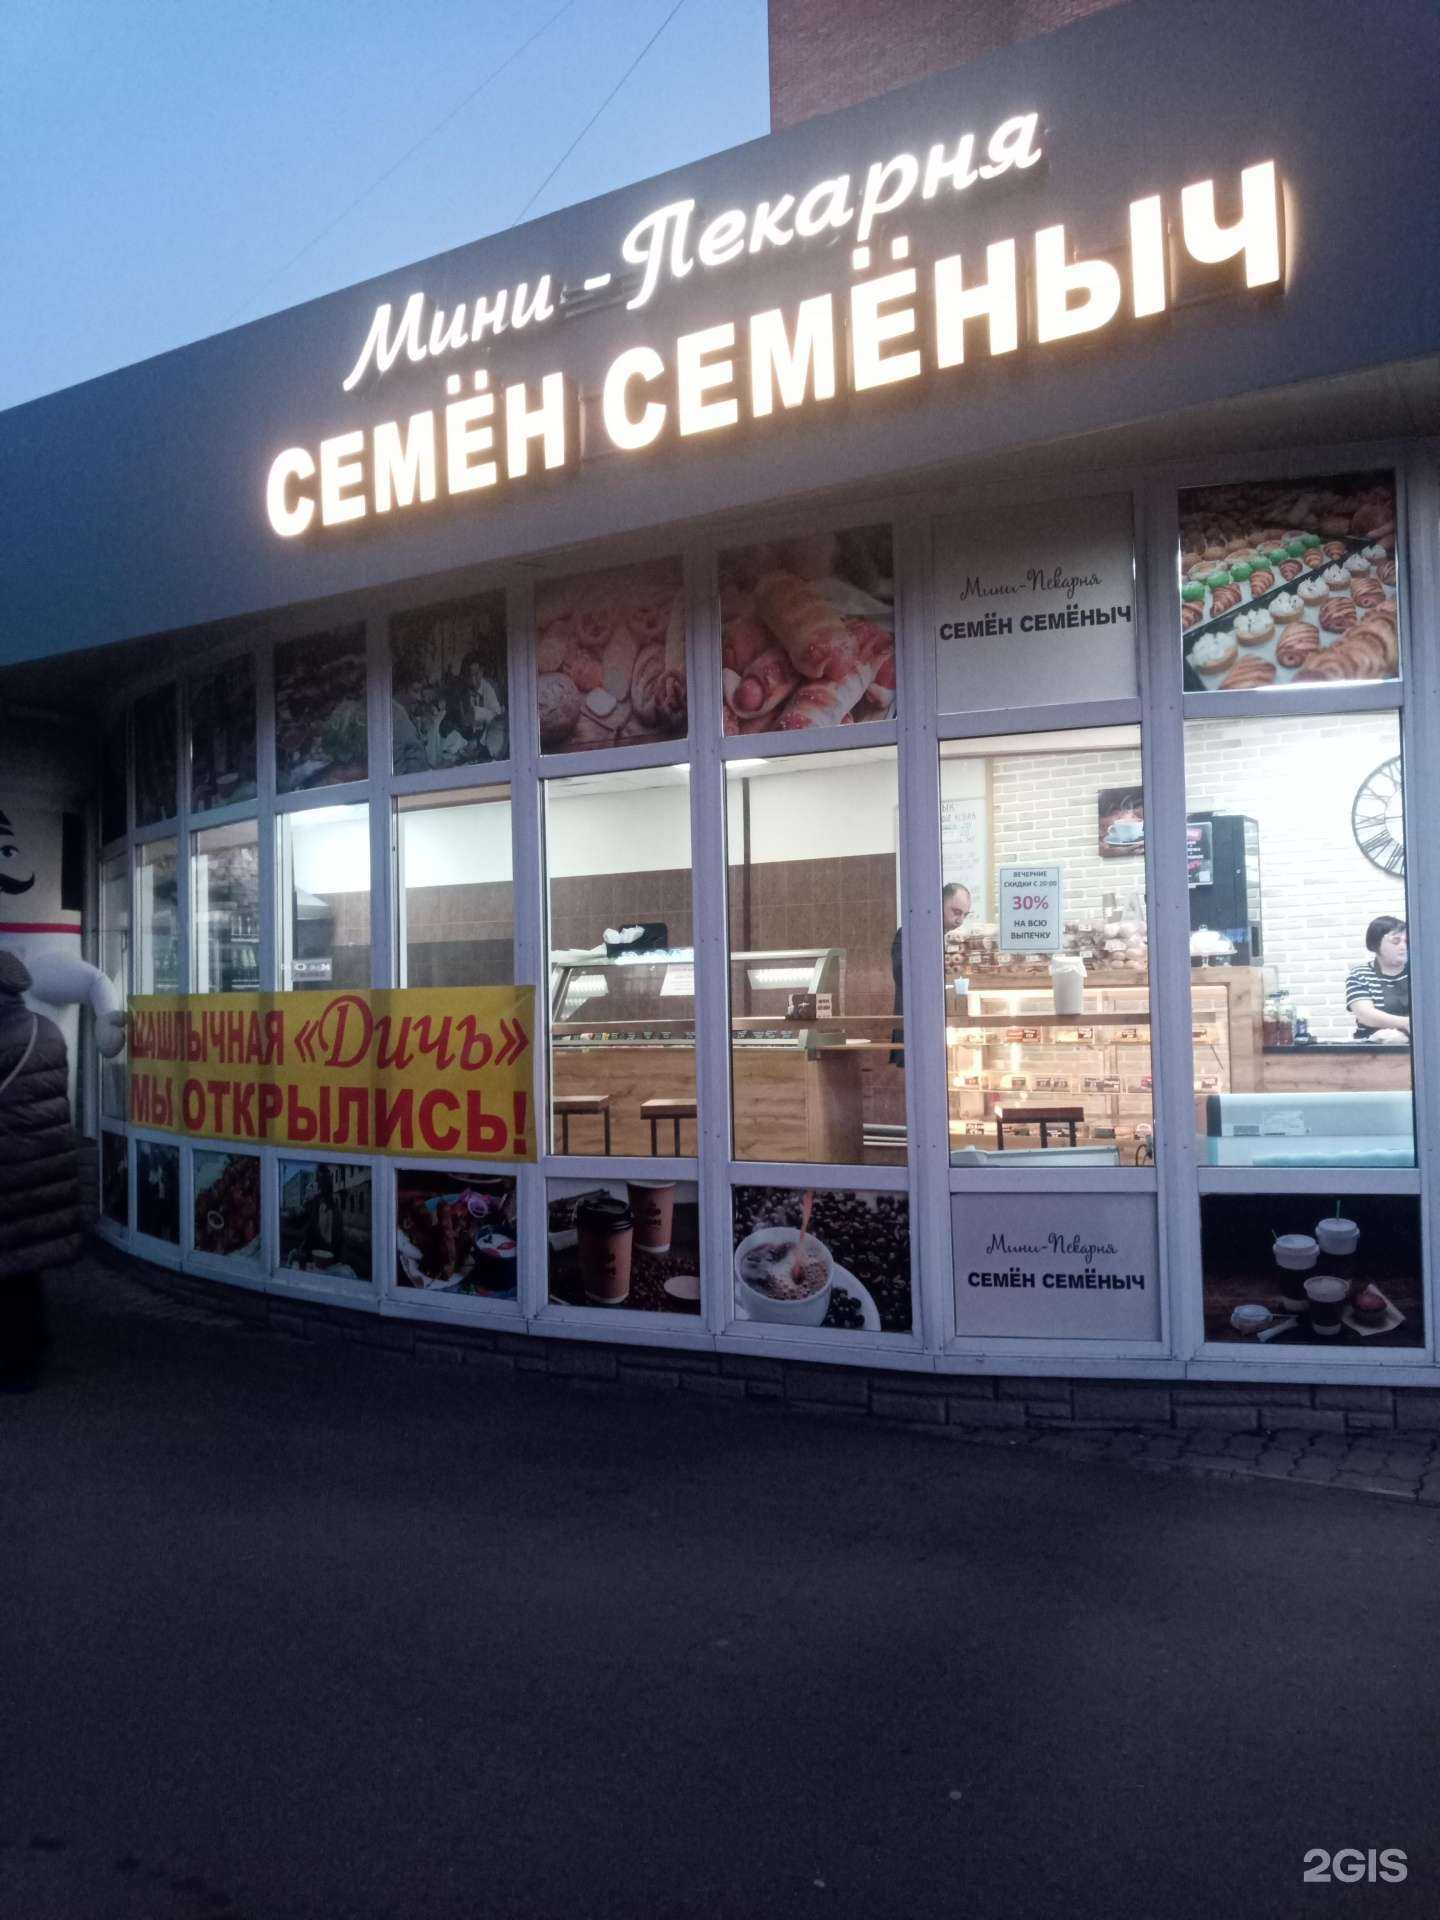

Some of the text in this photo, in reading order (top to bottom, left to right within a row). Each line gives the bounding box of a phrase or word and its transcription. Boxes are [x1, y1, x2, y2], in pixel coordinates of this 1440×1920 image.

[266, 160, 1281, 537] СЕМЁН СЕМЁНЫЧ
[939, 603, 1132, 641] СЕМЁН СЕМЁНЫЧ
[1012, 895, 1049, 910] 30%
[1011, 931, 1051, 940] ВЫПЕЧКУ
[131, 1073, 528, 1156] МЫ ОТКРЫЛИСЬ!
[968, 1267, 1145, 1290] СЕМЁН СЕМЁНЫЧ
